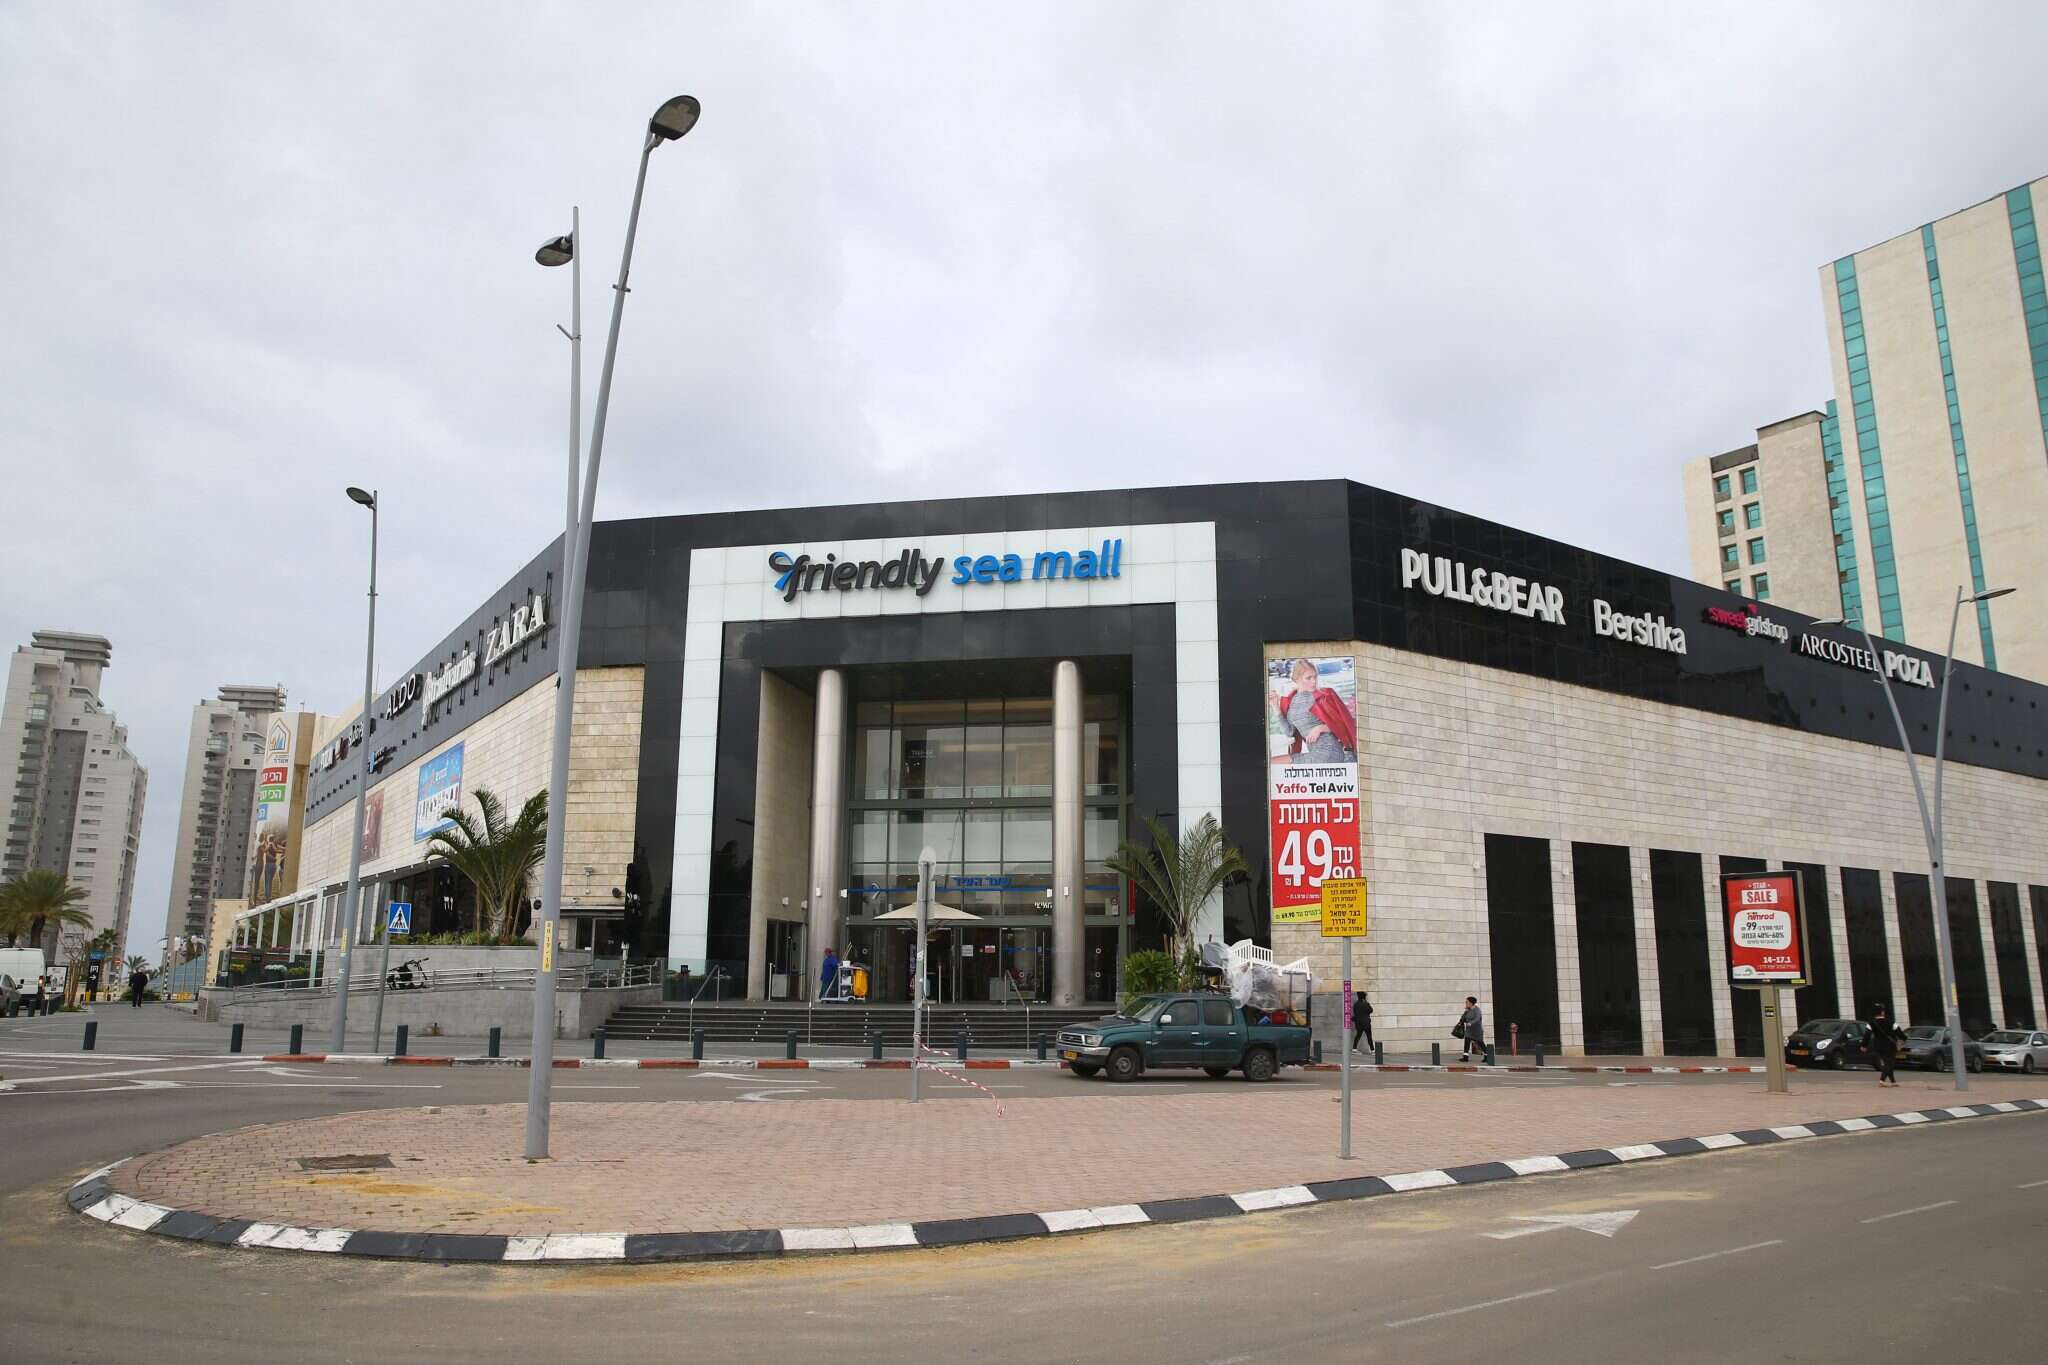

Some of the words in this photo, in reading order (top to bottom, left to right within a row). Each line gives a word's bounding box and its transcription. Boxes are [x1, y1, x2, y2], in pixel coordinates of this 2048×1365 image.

[769, 548, 944, 602] friendly
[952, 554, 1022, 584] sea
[1031, 539, 1122, 580] mall
[1401, 548, 1566, 625] PULL&BEAR
[484, 595, 546, 666] ZARA
[1593, 598, 1687, 655] Bershka
[1884, 650, 1936, 689] POZA
[385, 673, 416, 720] ALDO
[1276, 783, 1307, 793] Yaffo
[1309, 783, 1326, 793] Tel
[1328, 782, 1354, 793] Aviv
[1315, 767, 1347, 777] הפתיחה
[1279, 803, 1328, 824] החנות
[1331, 798, 1353, 823] כל
[1278, 829, 1332, 887] 49
[1333, 846, 1353, 864] עד
[1747, 891, 1772, 903] SALE
[1746, 921, 1757, 931] 99
